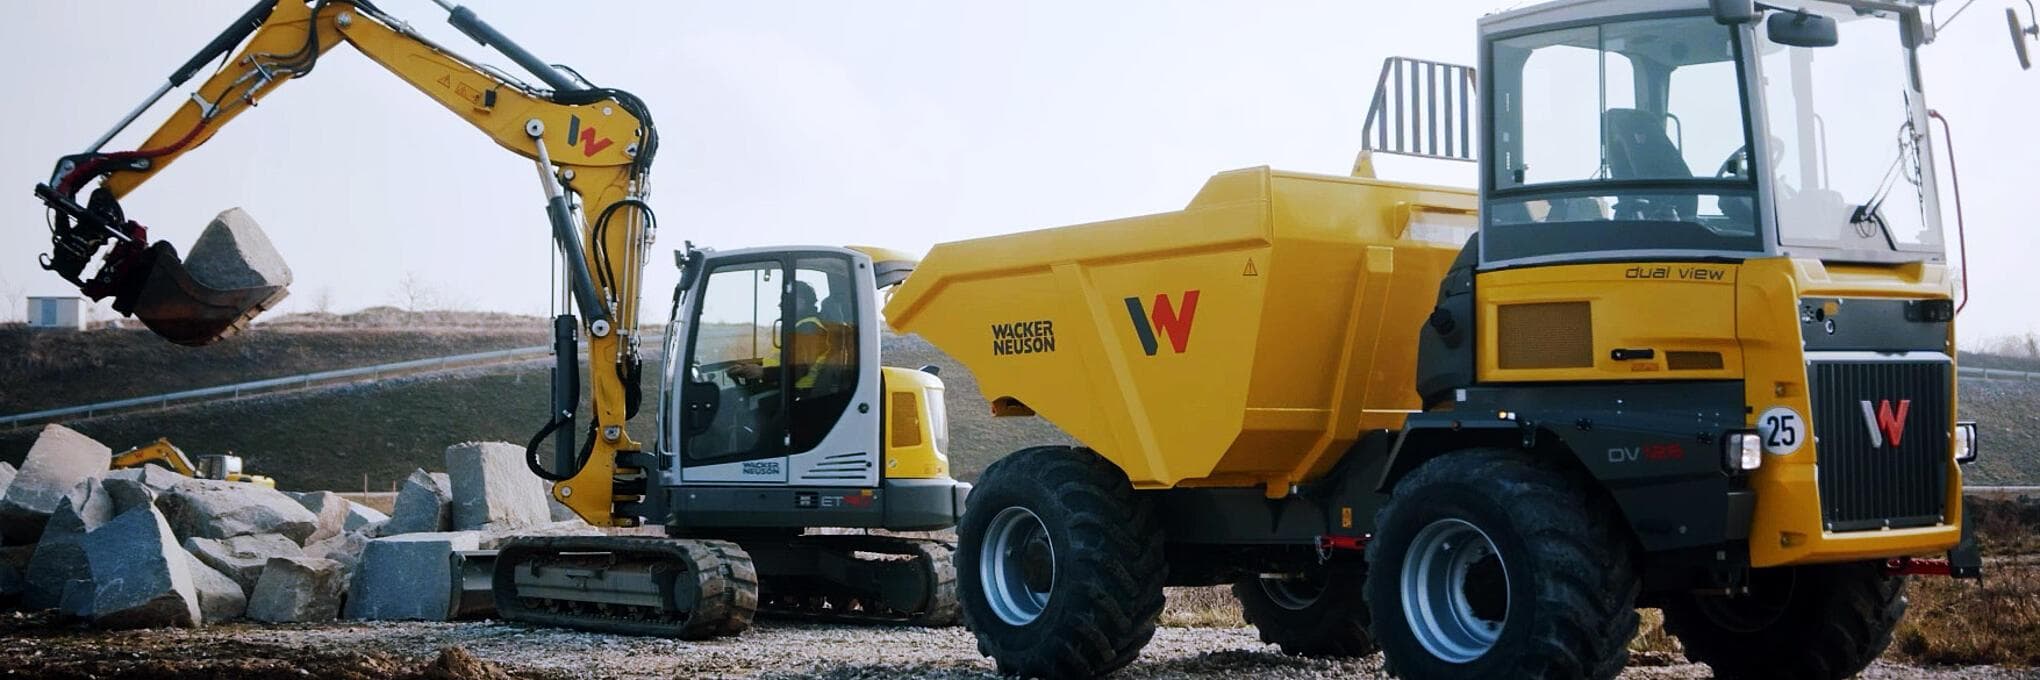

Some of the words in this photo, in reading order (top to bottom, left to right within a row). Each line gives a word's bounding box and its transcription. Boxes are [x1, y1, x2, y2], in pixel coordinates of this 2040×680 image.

[1625, 266, 1671, 279] dual
[1679, 267, 1724, 281] view
[992, 320, 1054, 339] WACKER
[1124, 289, 1200, 356] W
[993, 336, 1055, 356] NEUSON
[1767, 415, 1795, 447] 25
[1860, 399, 1911, 449] W
